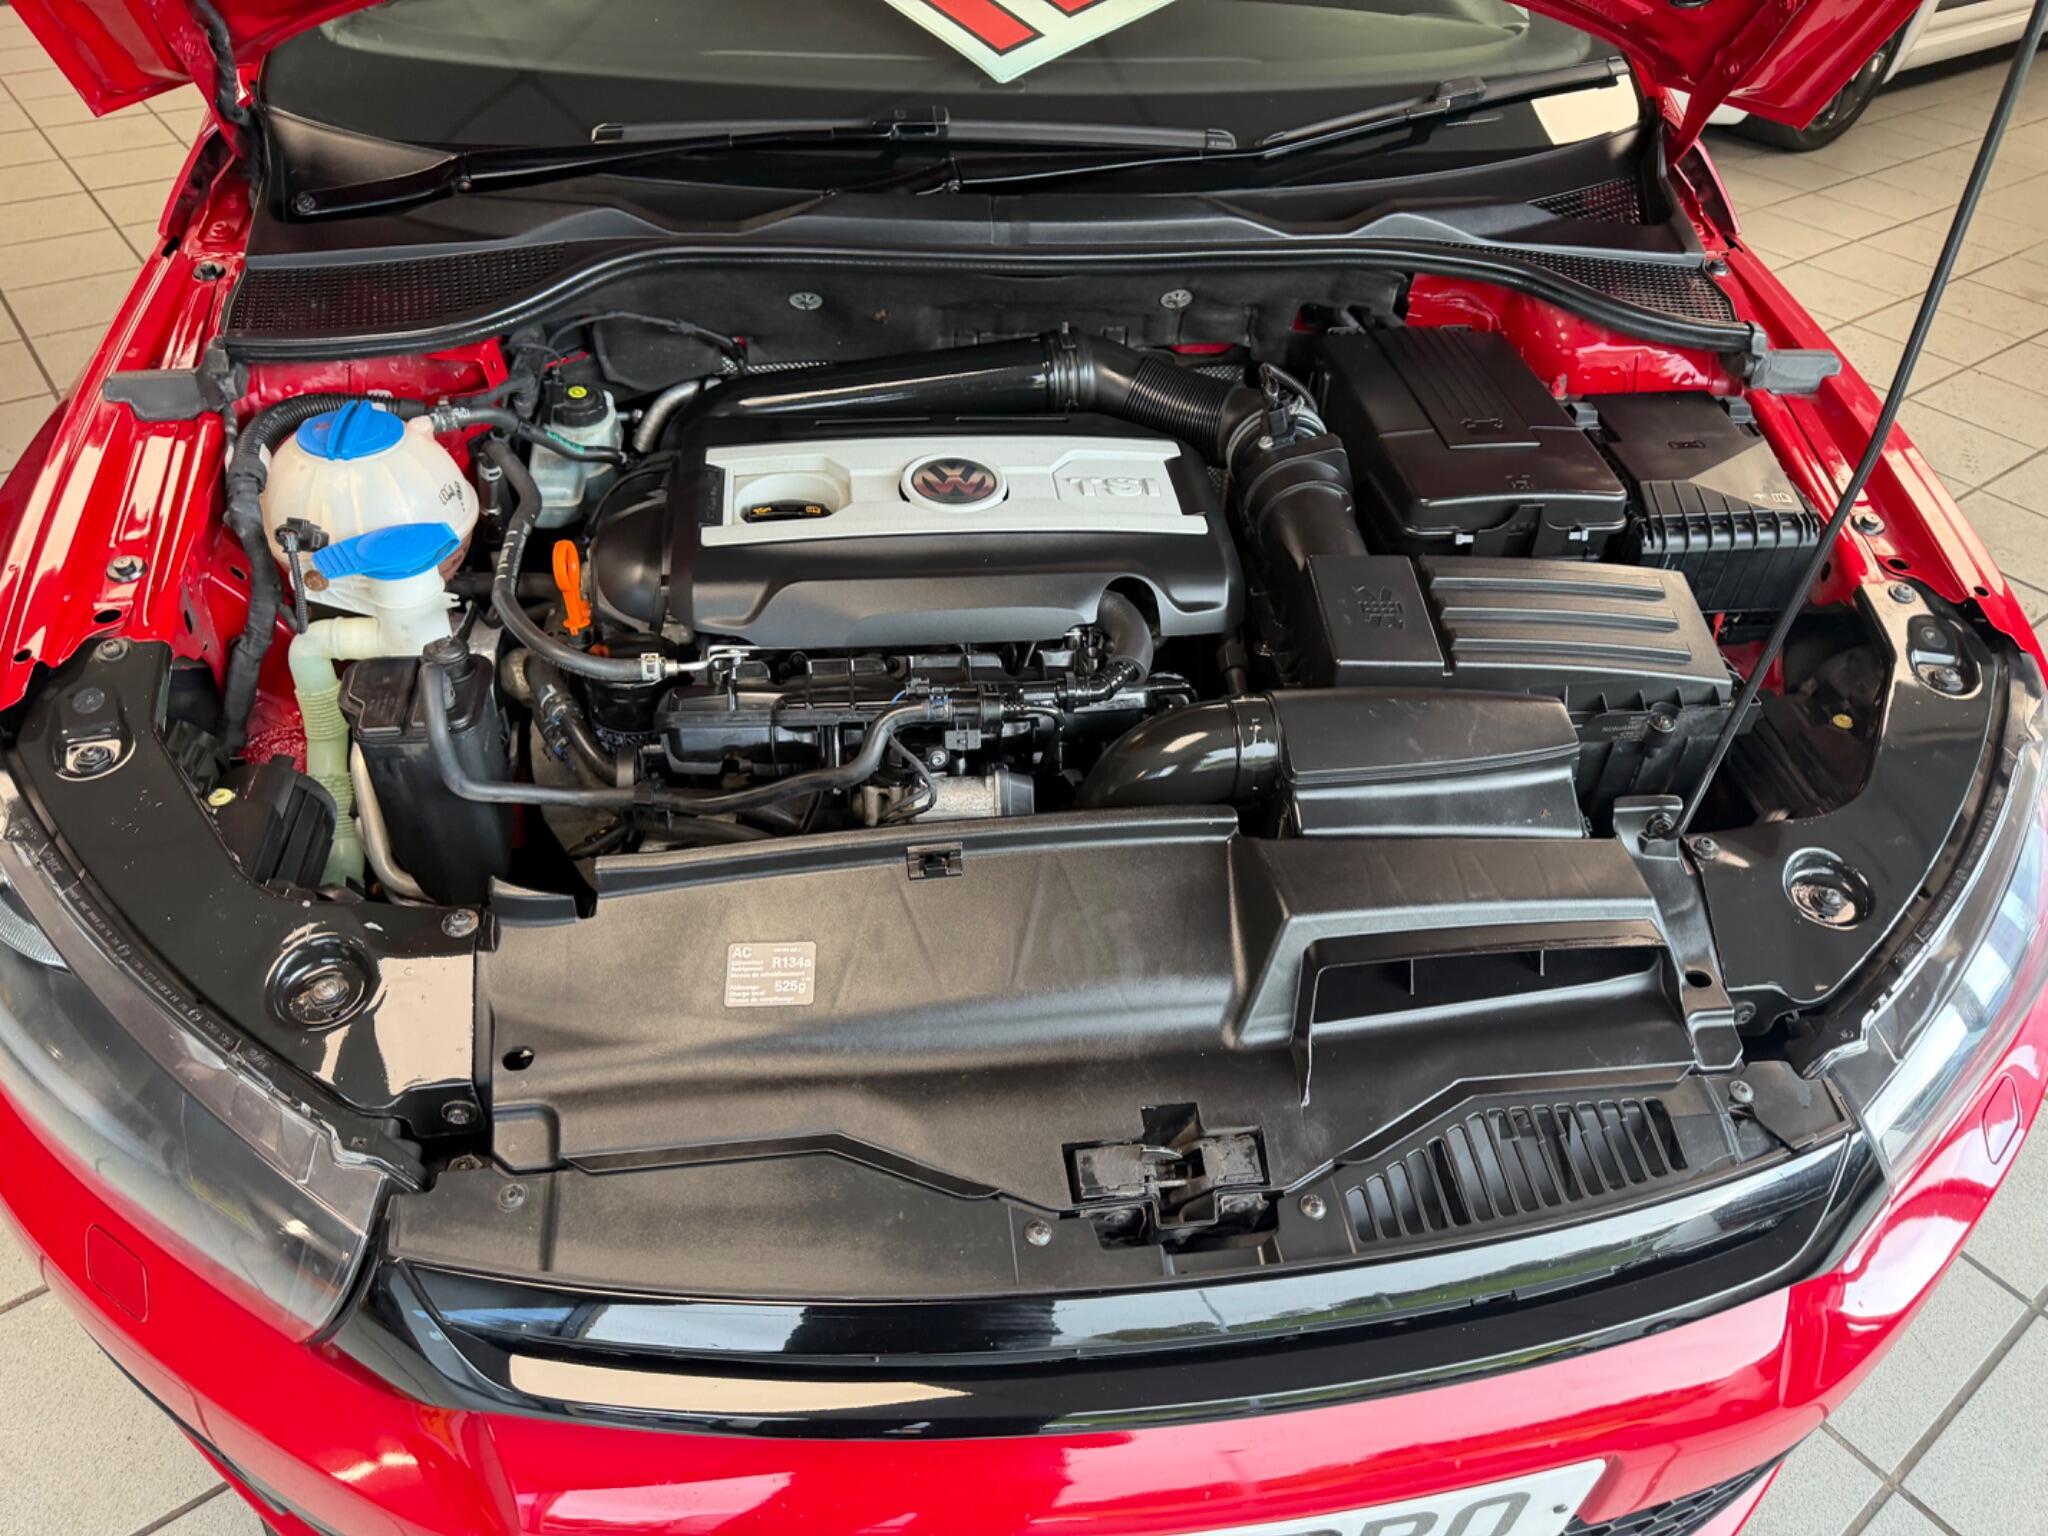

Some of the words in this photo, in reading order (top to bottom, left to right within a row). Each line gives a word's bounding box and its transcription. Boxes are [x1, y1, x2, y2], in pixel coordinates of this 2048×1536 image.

[1064, 477, 1161, 497] TSI
[733, 947, 753, 959] AC
[772, 956, 812, 968] R134a
[775, 980, 806, 994] 525g
